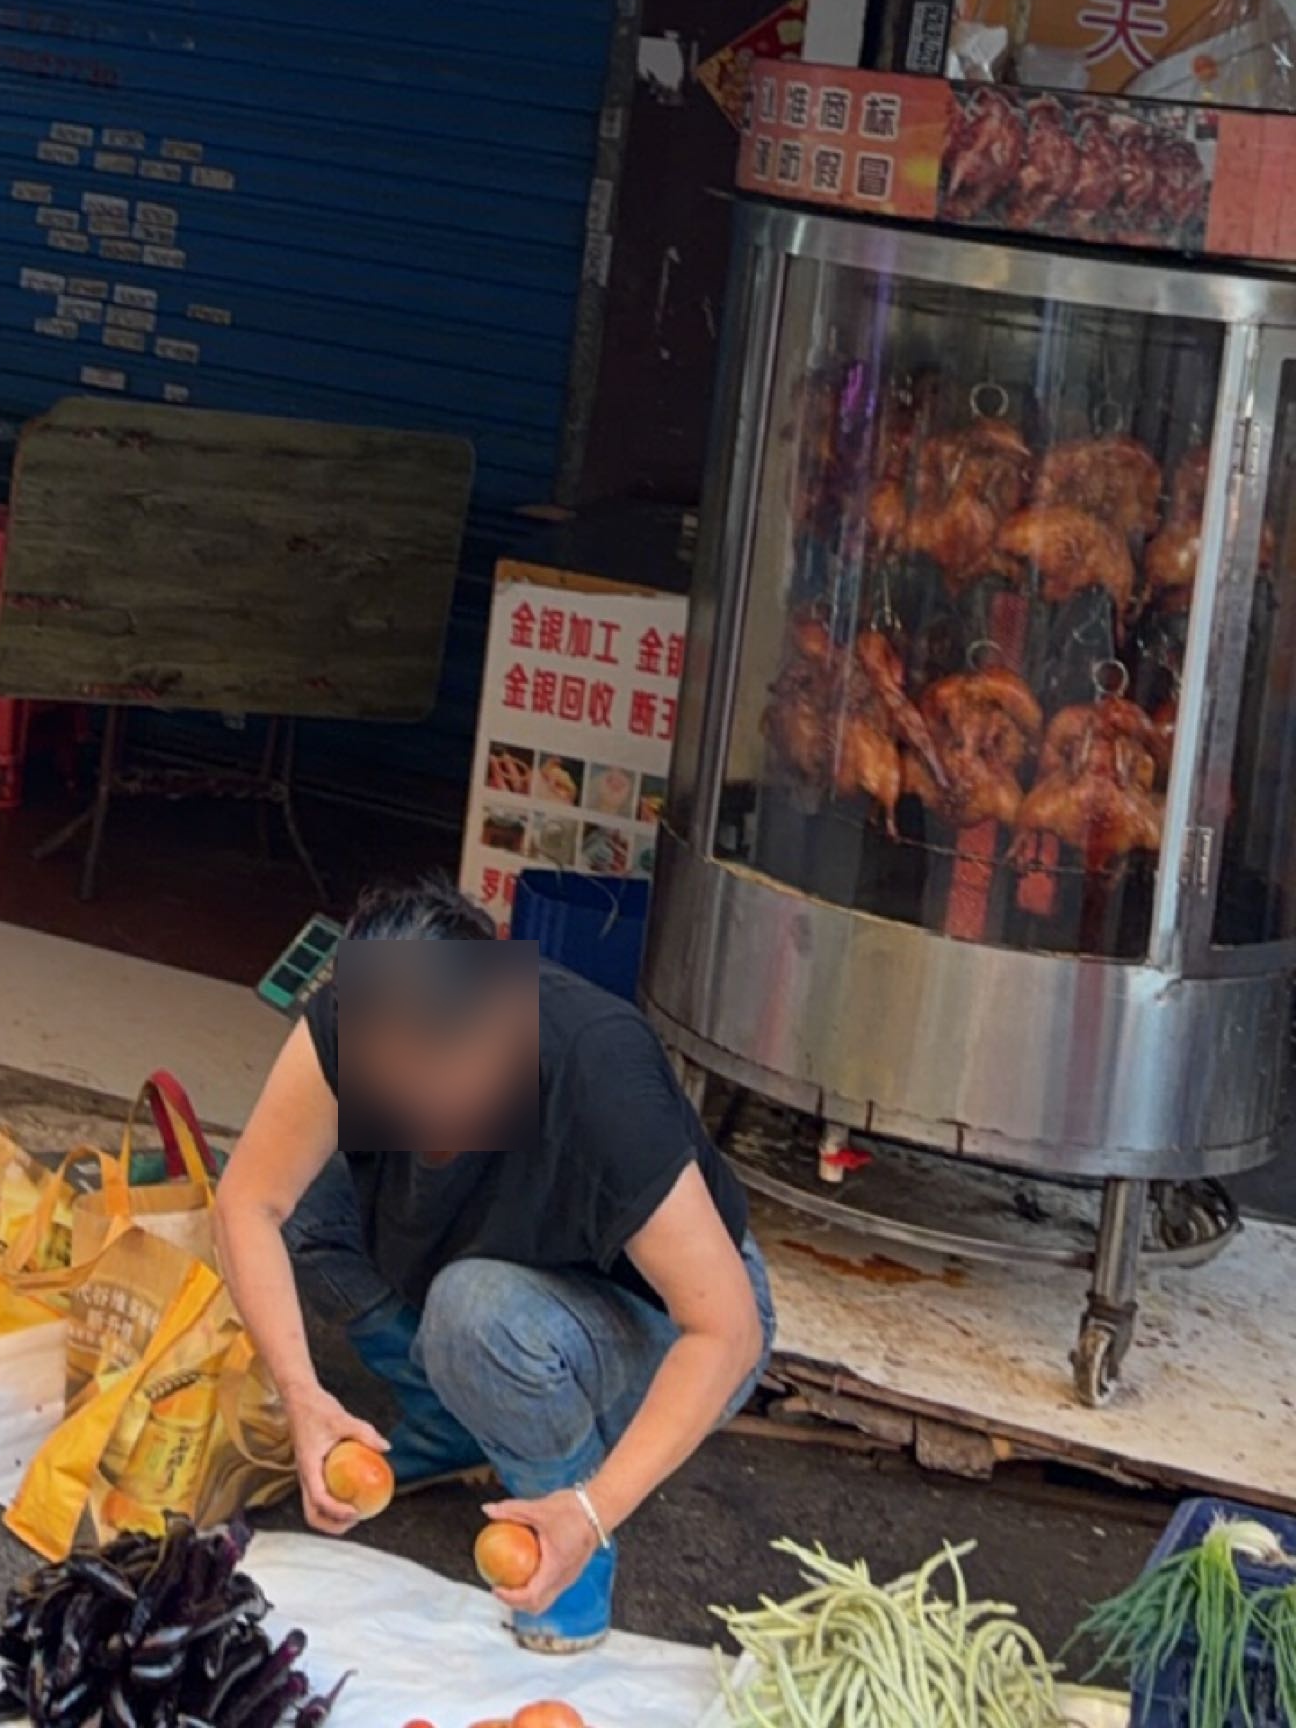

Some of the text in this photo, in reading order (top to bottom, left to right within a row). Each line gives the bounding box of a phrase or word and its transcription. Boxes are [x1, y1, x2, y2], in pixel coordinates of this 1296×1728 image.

[509, 601, 619, 665] 金银加工
[503, 662, 614, 727] 金银回收
